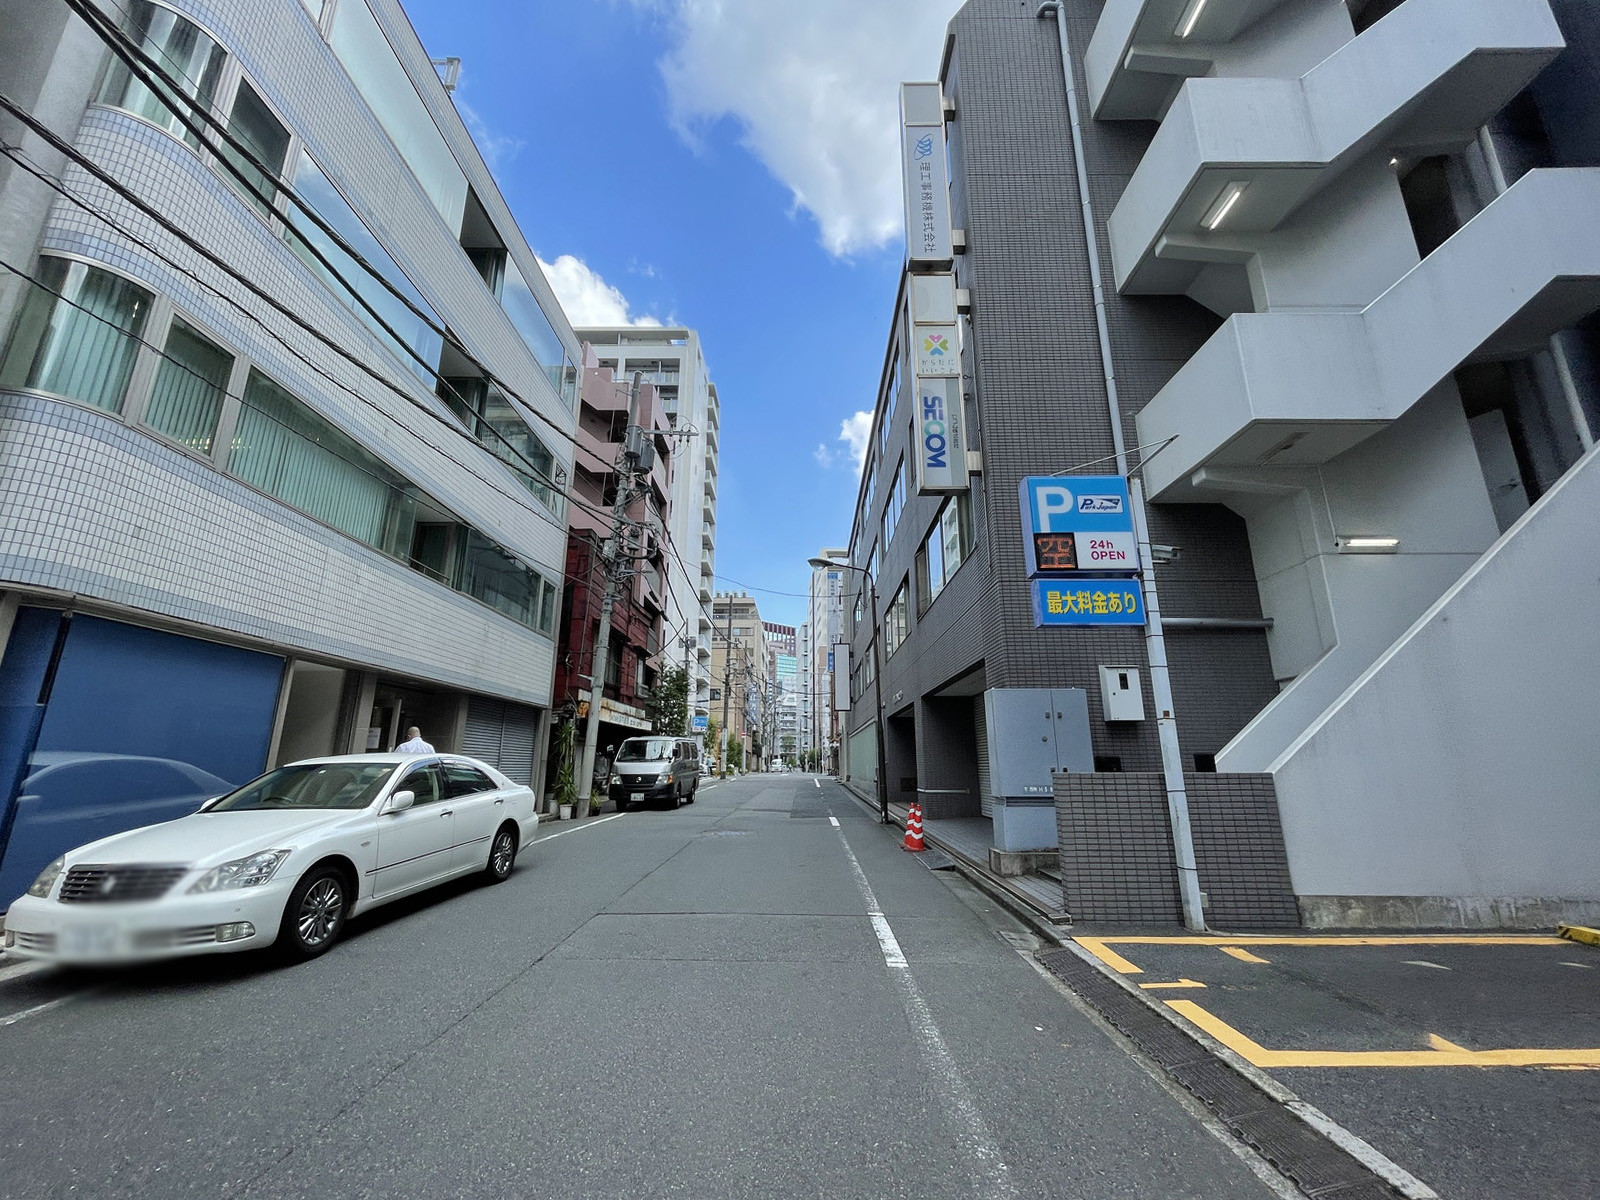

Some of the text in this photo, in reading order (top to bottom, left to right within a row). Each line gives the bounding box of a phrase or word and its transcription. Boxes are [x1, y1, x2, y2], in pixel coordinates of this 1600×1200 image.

[919, 162, 937, 253] 理工事務機株式会社
[924, 396, 947, 468] SECOM
[1036, 486, 1074, 533] P
[1080, 498, 1117, 511] Park Japan
[1037, 534, 1076, 569] 空
[1090, 540, 1114, 549] 24h
[1091, 551, 1126, 560] OPEN
[1047, 591, 1137, 614] 最大料金あり
